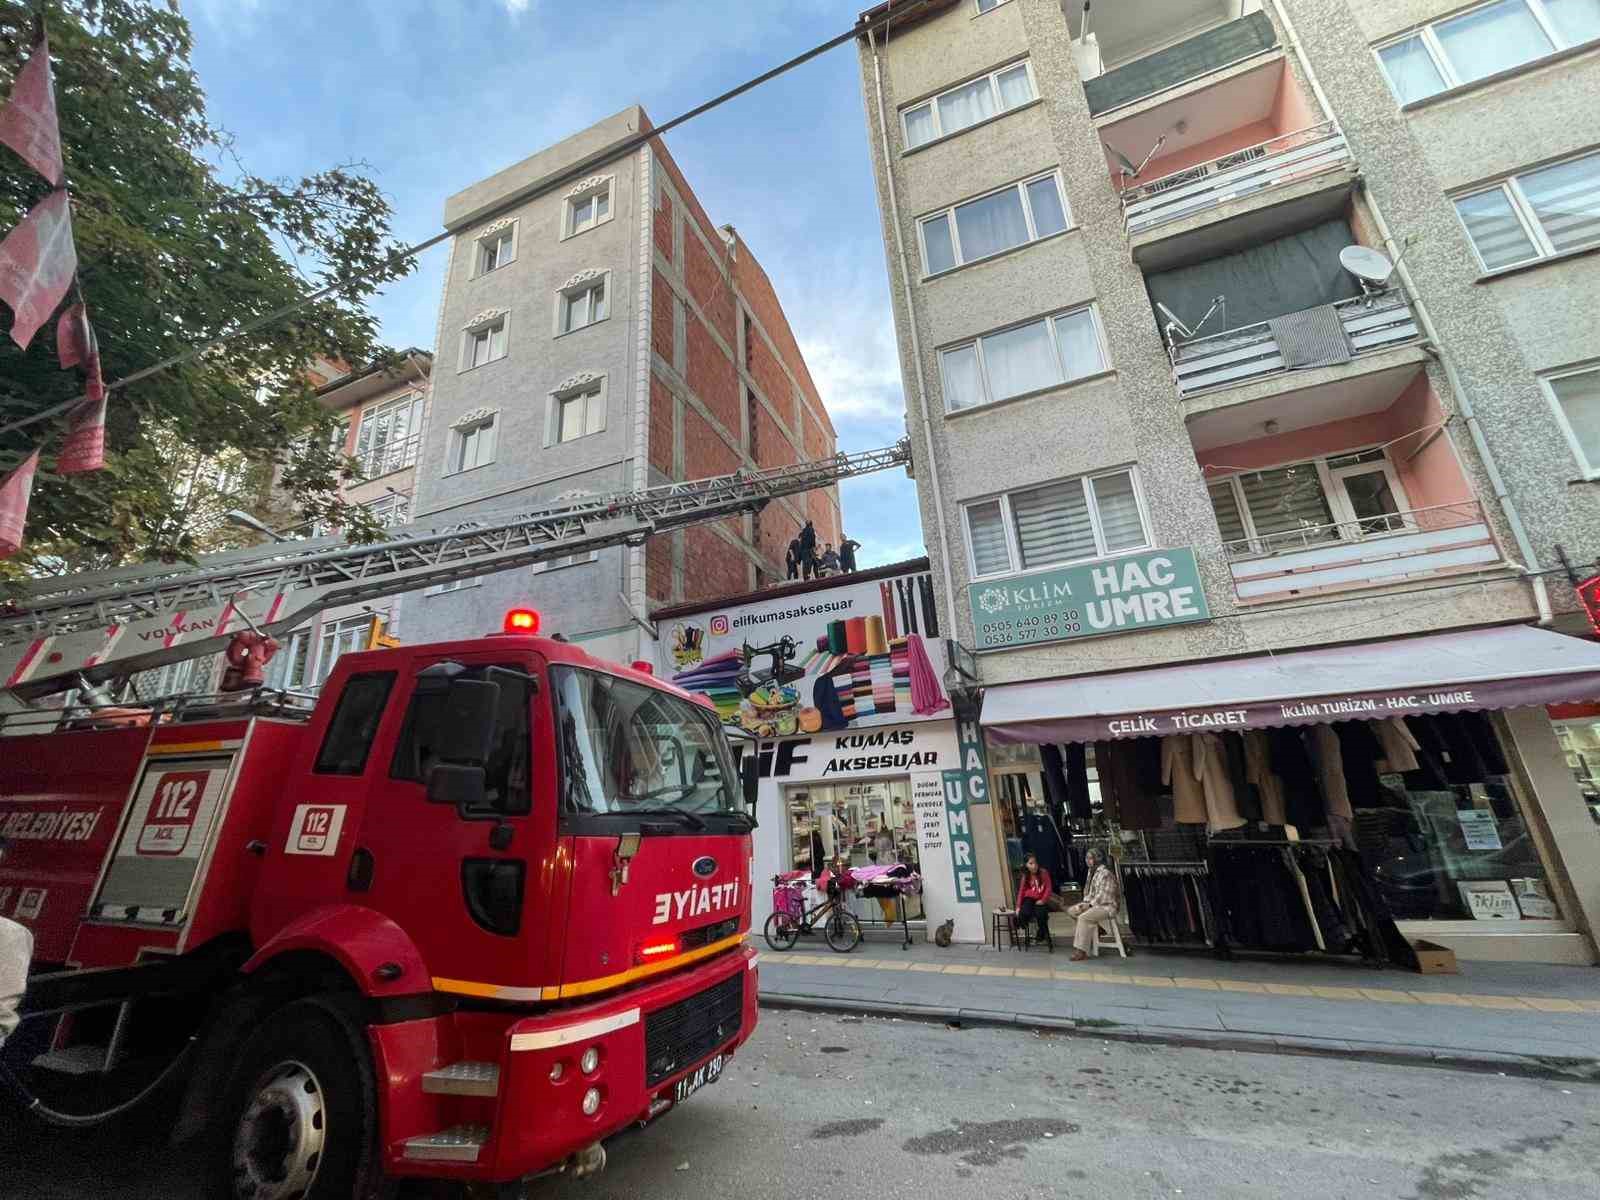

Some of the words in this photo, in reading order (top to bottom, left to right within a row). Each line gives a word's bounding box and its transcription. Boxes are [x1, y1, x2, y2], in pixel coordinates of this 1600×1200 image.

[1091, 557, 1175, 596] HAC
[733, 599, 854, 628] elifkumasaksesuar
[983, 620, 1012, 633] 0505
[1016, 616, 1040, 628] 640
[1043, 613, 1058, 624] 89
[1063, 610, 1078, 621] 30
[1085, 586, 1199, 629] UMRE
[137, 618, 214, 641] VOLKAN
[984, 634, 1013, 645] 0536
[1018, 629, 1037, 640] 577
[1044, 625, 1058, 636] 30
[1064, 622, 1080, 633] 90
[1280, 702, 1320, 719] İKLİM
[1320, 697, 1376, 715] TURİZM
[1386, 695, 1419, 709] HAC
[1429, 691, 1475, 706] UMRE
[1108, 715, 1158, 736] ÇELİK
[1171, 709, 1248, 729] TİCARET
[960, 722, 985, 799] HAC
[156, 780, 198, 818] 112
[3, 805, 105, 840] BELEDİYESİ
[306, 812, 329, 832] 112
[945, 780, 976, 897] UMRE
